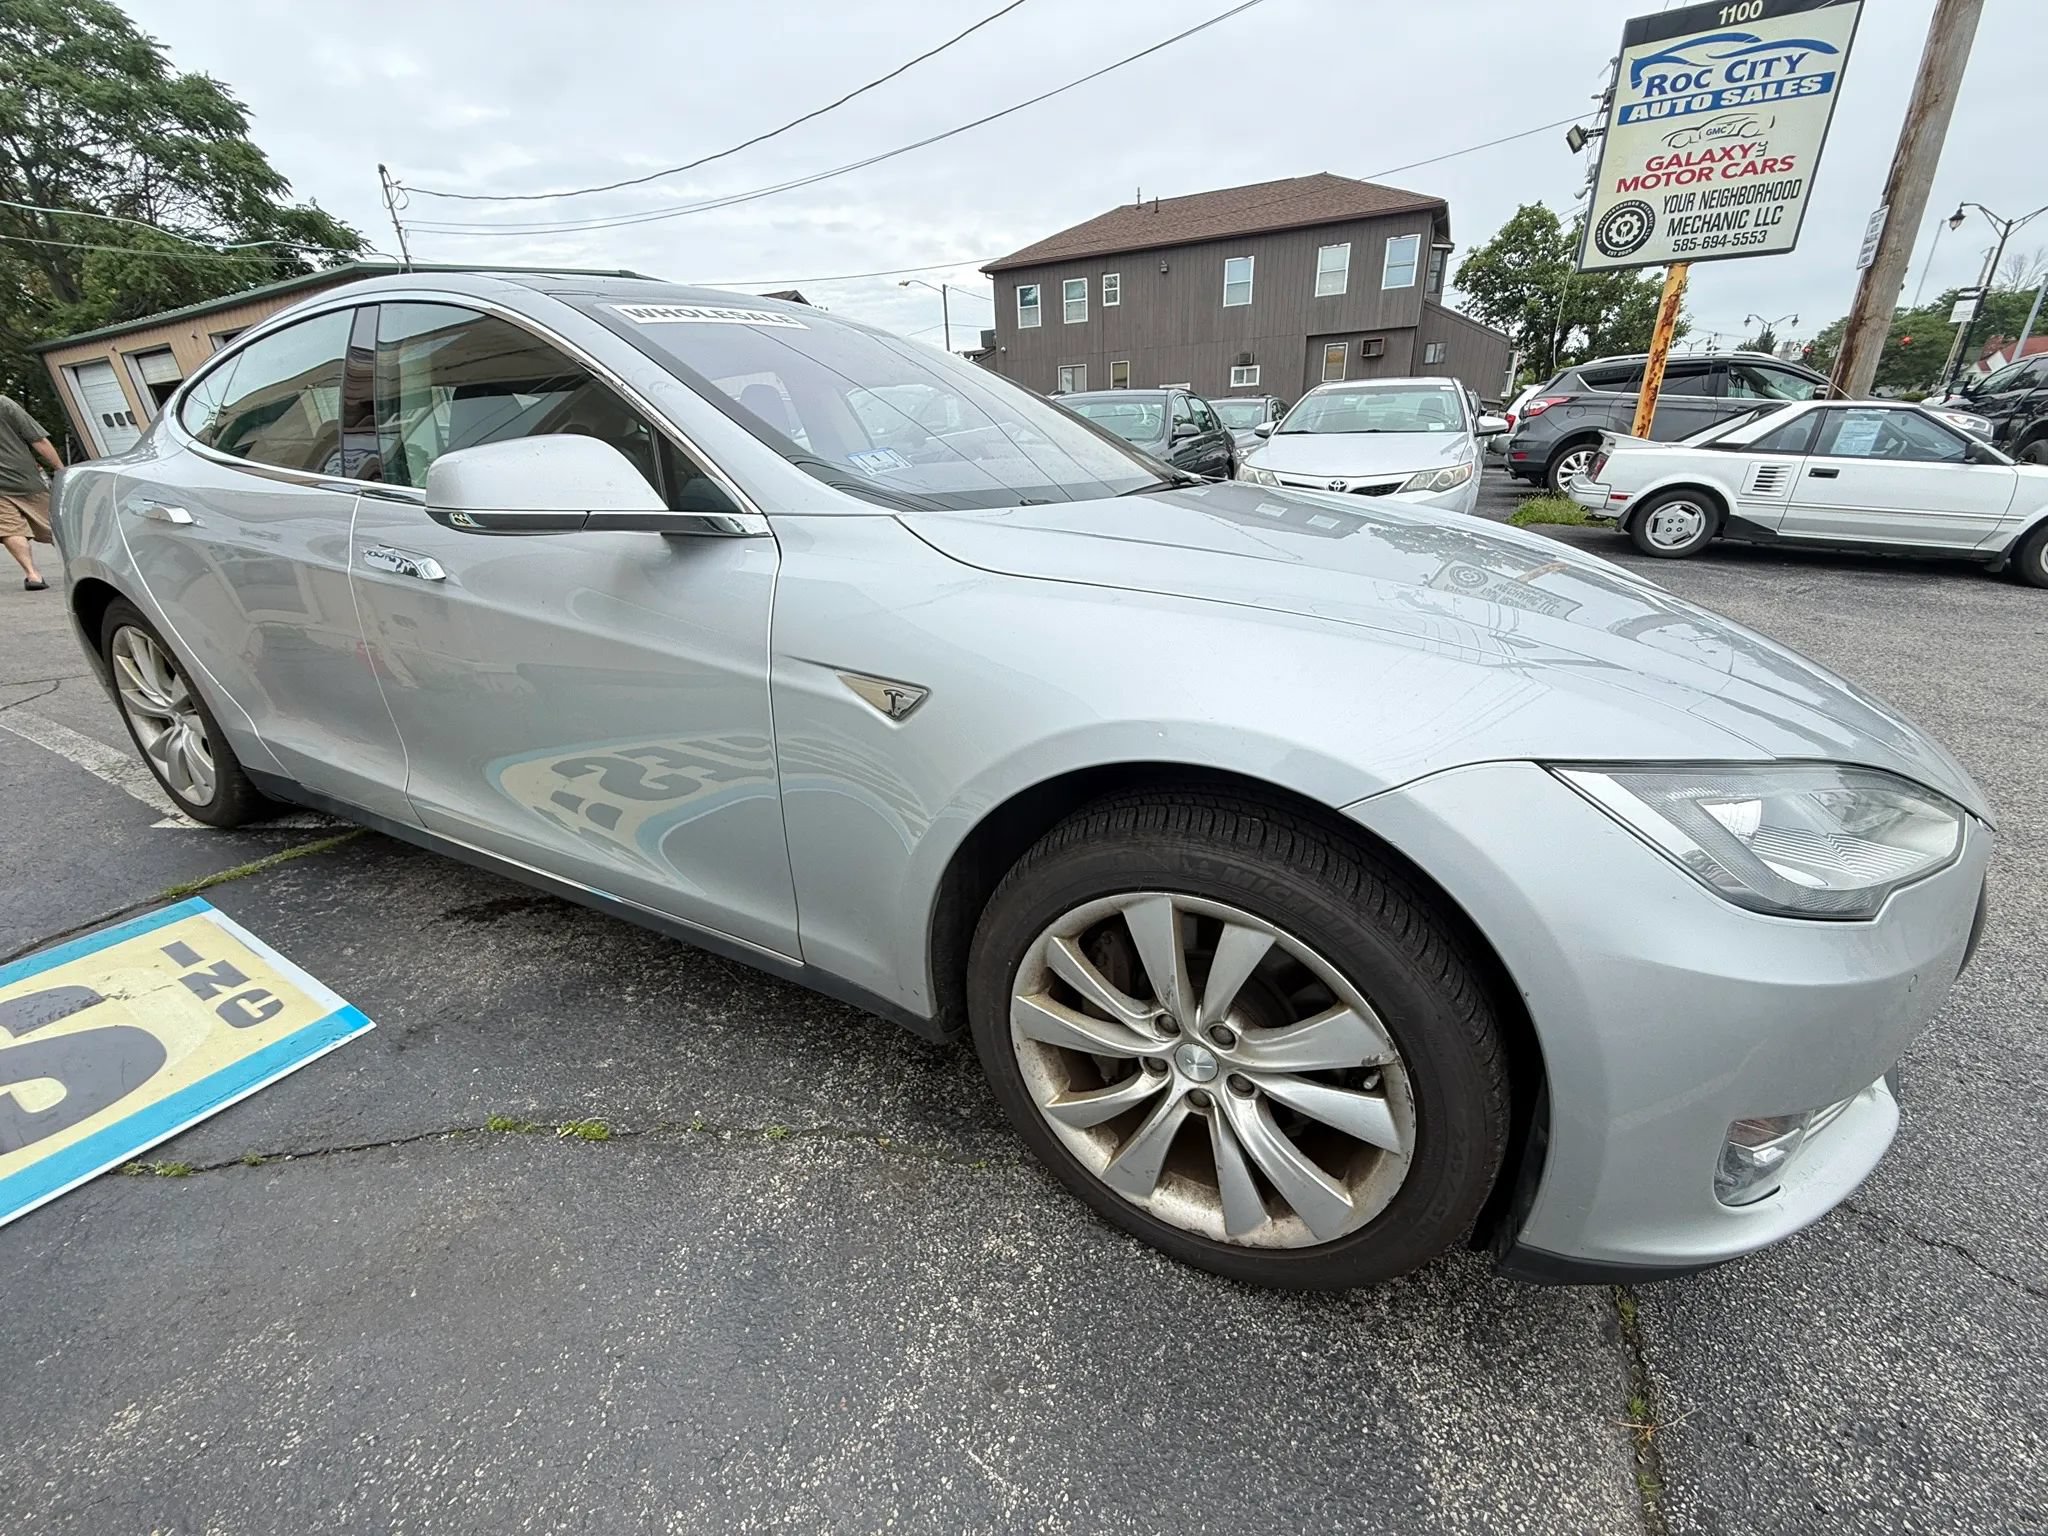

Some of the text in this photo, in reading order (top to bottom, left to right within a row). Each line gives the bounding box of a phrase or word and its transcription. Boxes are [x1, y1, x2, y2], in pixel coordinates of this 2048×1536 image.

[1719, 0, 1763, 25] 1100
[1643, 52, 1810, 98] ROC CITY
[1627, 76, 1823, 122] AUTO SALES
[1706, 126, 1727, 136] GMC
[1646, 142, 1757, 172] GALAXY
[1616, 155, 1797, 193] MOTOR CARS
[1663, 192, 1696, 215] YOUR
[1698, 178, 1803, 211] NEIGHBORHOOD
[1666, 209, 1750, 237] MECHANIC
[1754, 205, 1784, 228] LLC
[1672, 229, 1767, 253] 585-694-5553
[625, 308, 799, 325] WHOLESALE
[160, 940, 285, 1029] INC
